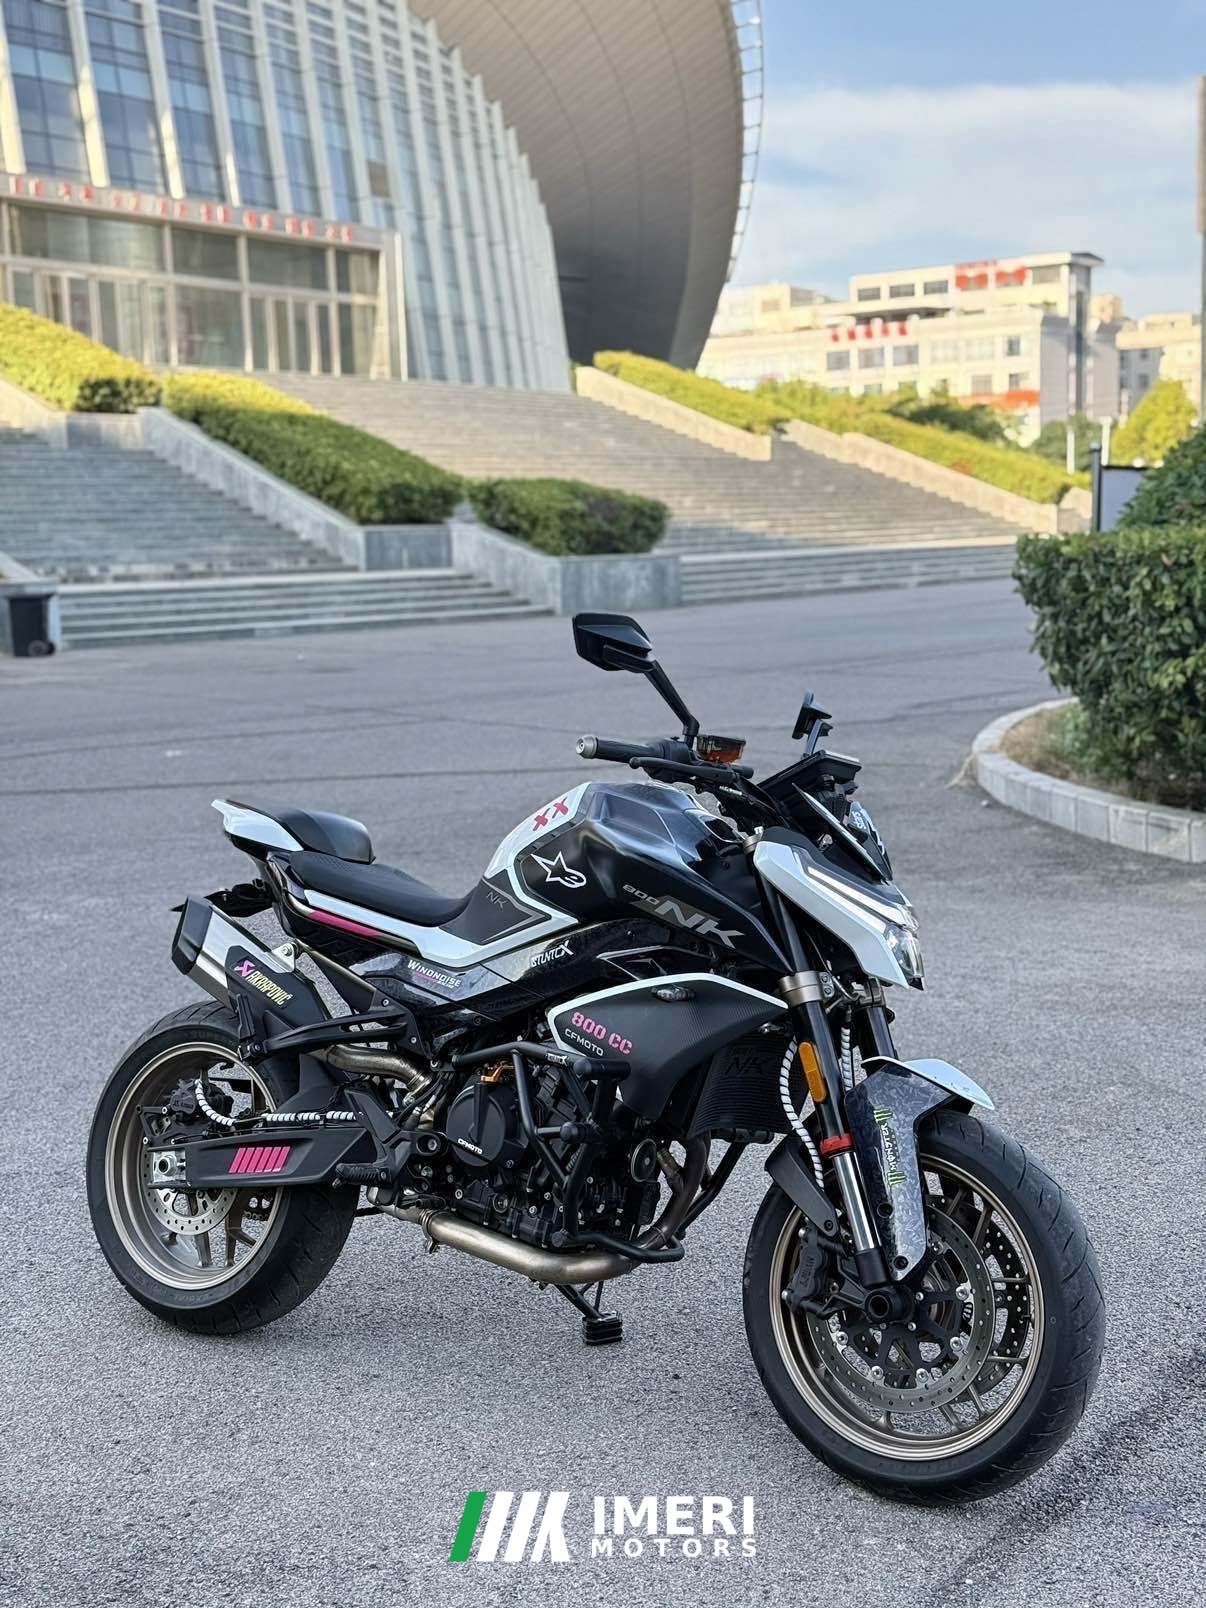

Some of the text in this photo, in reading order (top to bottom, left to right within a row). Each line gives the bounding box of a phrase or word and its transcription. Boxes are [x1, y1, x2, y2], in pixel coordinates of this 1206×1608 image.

[486, 891, 508, 910] NK
[621, 884, 745, 949] 800 NK
[564, 1028, 604, 1057] CFMOTO
[571, 1011, 633, 1055] 800 CC
